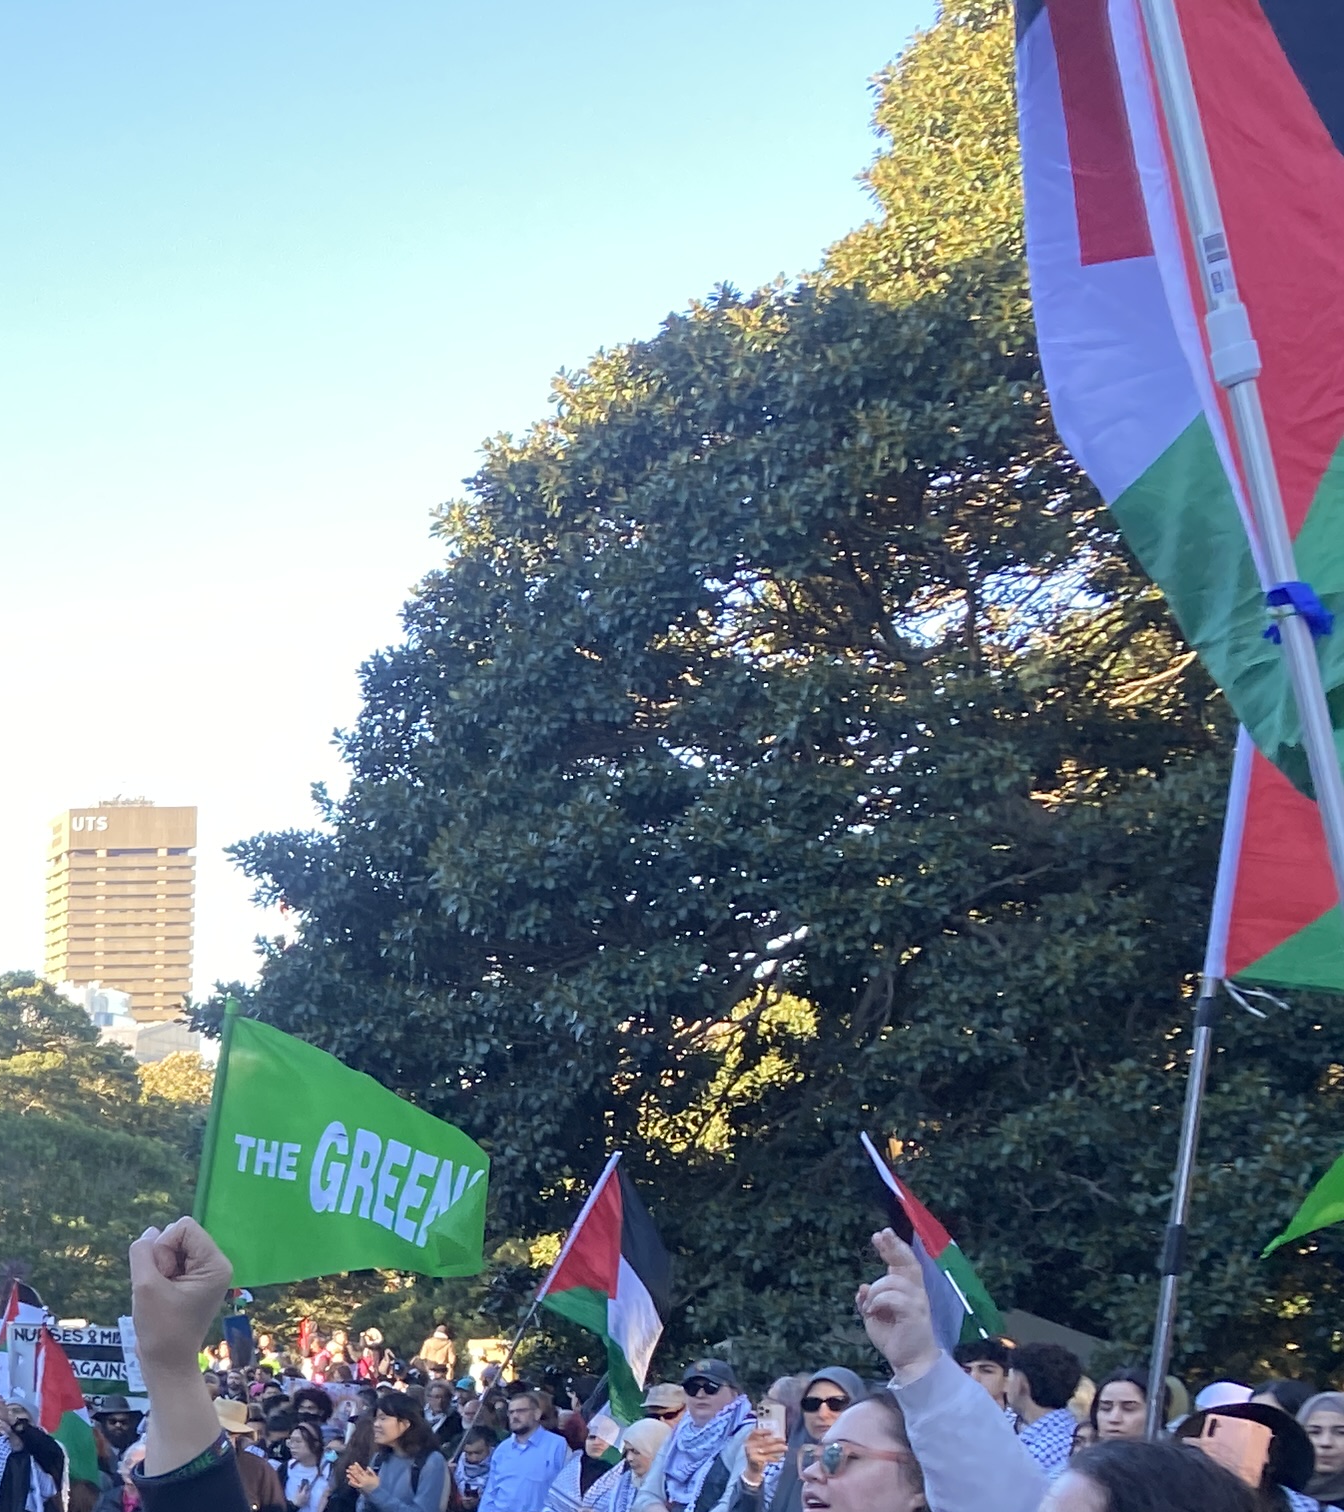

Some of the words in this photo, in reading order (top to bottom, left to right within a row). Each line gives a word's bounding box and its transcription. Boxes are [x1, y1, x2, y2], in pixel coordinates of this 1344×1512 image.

[72, 816, 108, 832] UTS
[235, 1133, 301, 1181] THE
[309, 1120, 485, 1249] GREEN
[14, 1328, 84, 1344] NUSES
[71, 1361, 128, 1380] AGAINS
